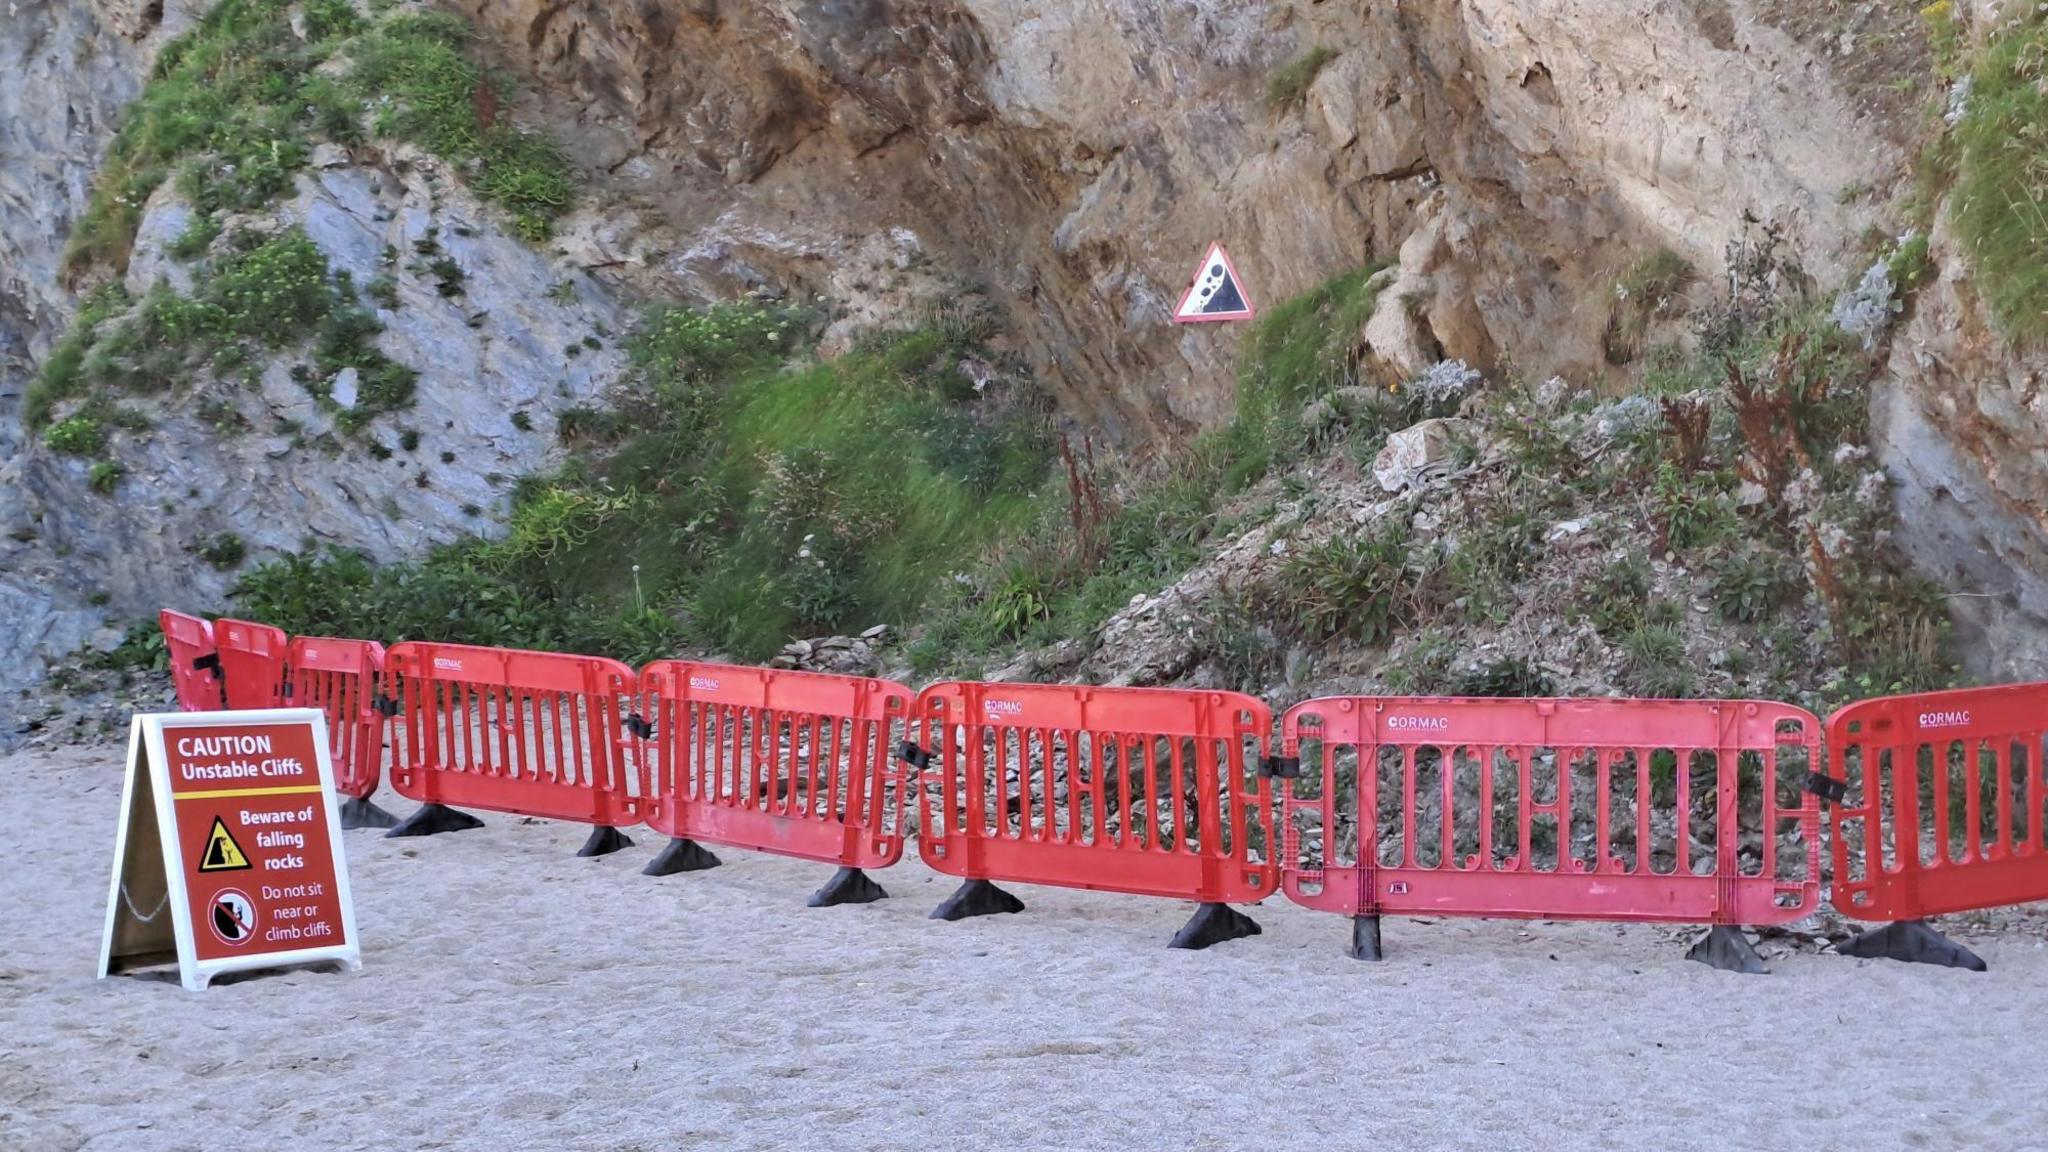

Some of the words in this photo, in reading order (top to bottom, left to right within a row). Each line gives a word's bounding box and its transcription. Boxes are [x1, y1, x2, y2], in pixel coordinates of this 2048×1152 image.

[985, 700, 1022, 713] CORMAC
[1388, 716, 1448, 729] CORMAC
[1919, 710, 1970, 725] CORMAC
[177, 735, 272, 757] CAUTION
[181, 760, 258, 780] Unstable
[260, 757, 303, 776] Cliffs
[240, 810, 295, 825] Beware
[297, 806, 313, 821] of
[256, 831, 304, 849] falling
[264, 853, 304, 870] rocks
[262, 886, 281, 900] Do
[284, 884, 306, 898] not
[308, 881, 323, 896] sit
[273, 906, 302, 920] near
[304, 905, 318, 917] or
[265, 924, 301, 941] climb
[303, 921, 332, 938] cliffs
